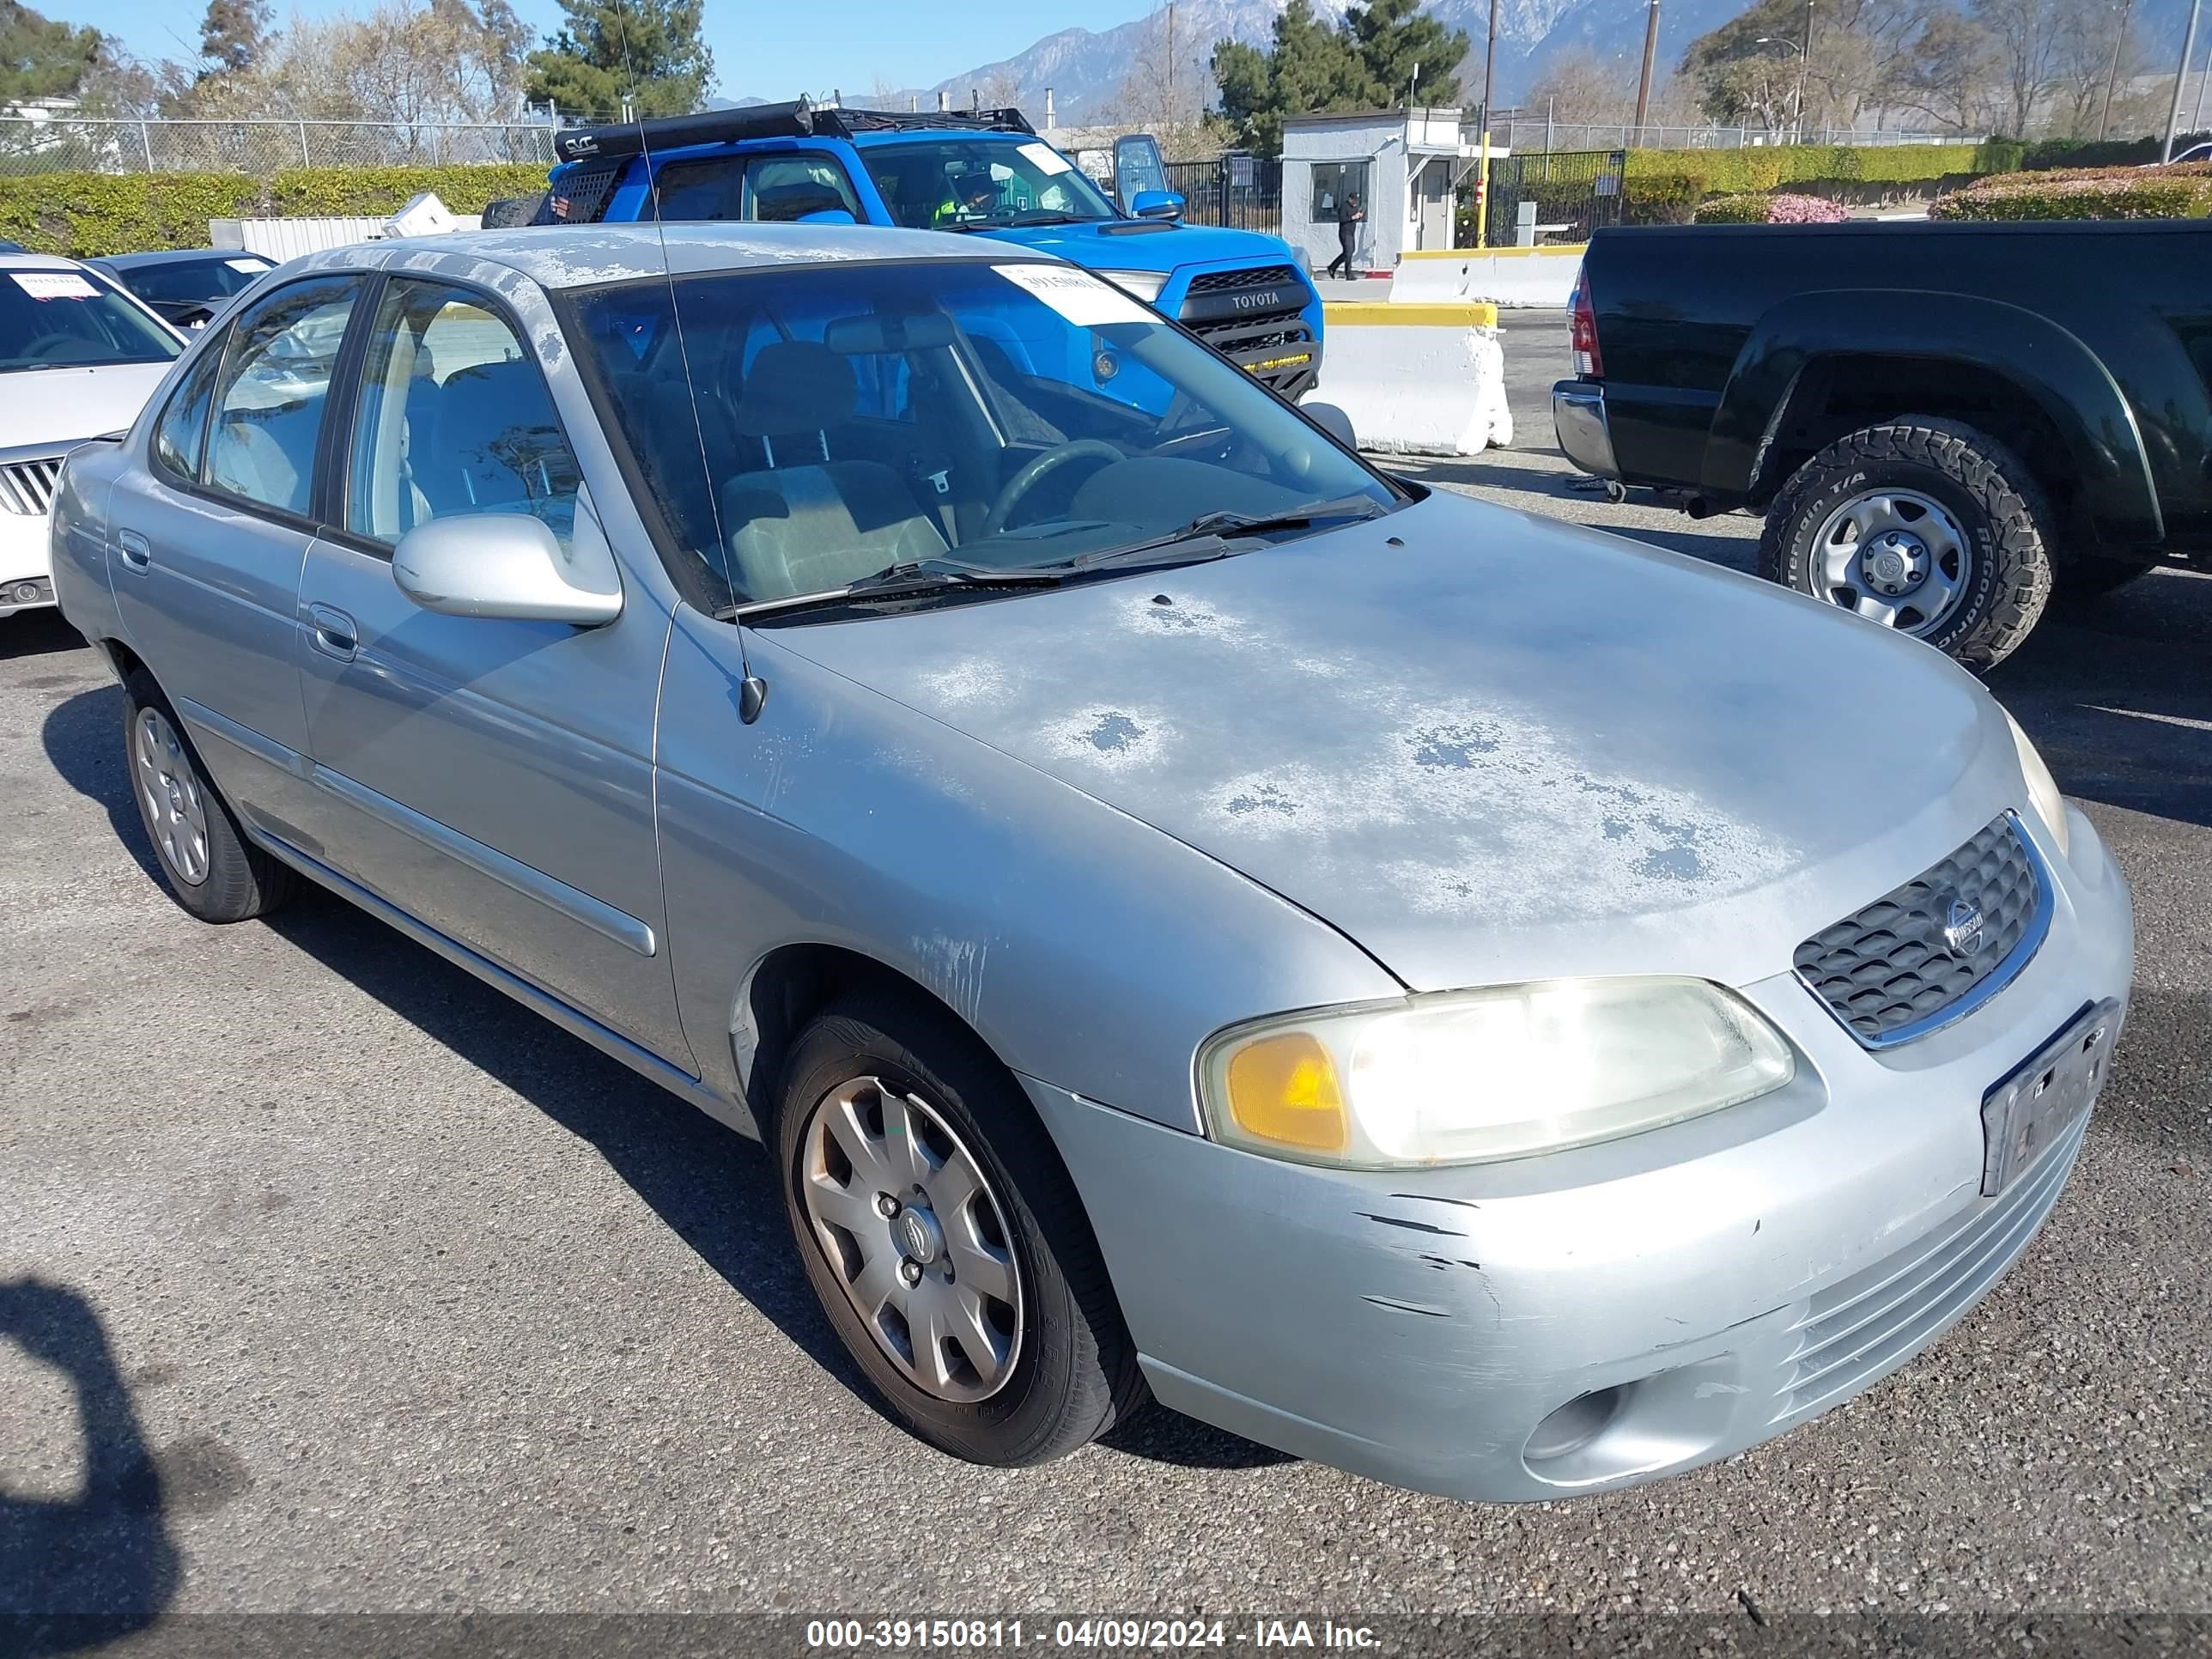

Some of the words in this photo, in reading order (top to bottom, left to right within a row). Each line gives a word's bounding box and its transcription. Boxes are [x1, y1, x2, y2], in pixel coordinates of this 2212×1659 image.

[1232, 291, 1279, 310] TOYOTA
[1829, 471, 1867, 494] T/A
[1936, 526, 1994, 649] BFGoodric
[1952, 911, 1984, 945] NISSAN
